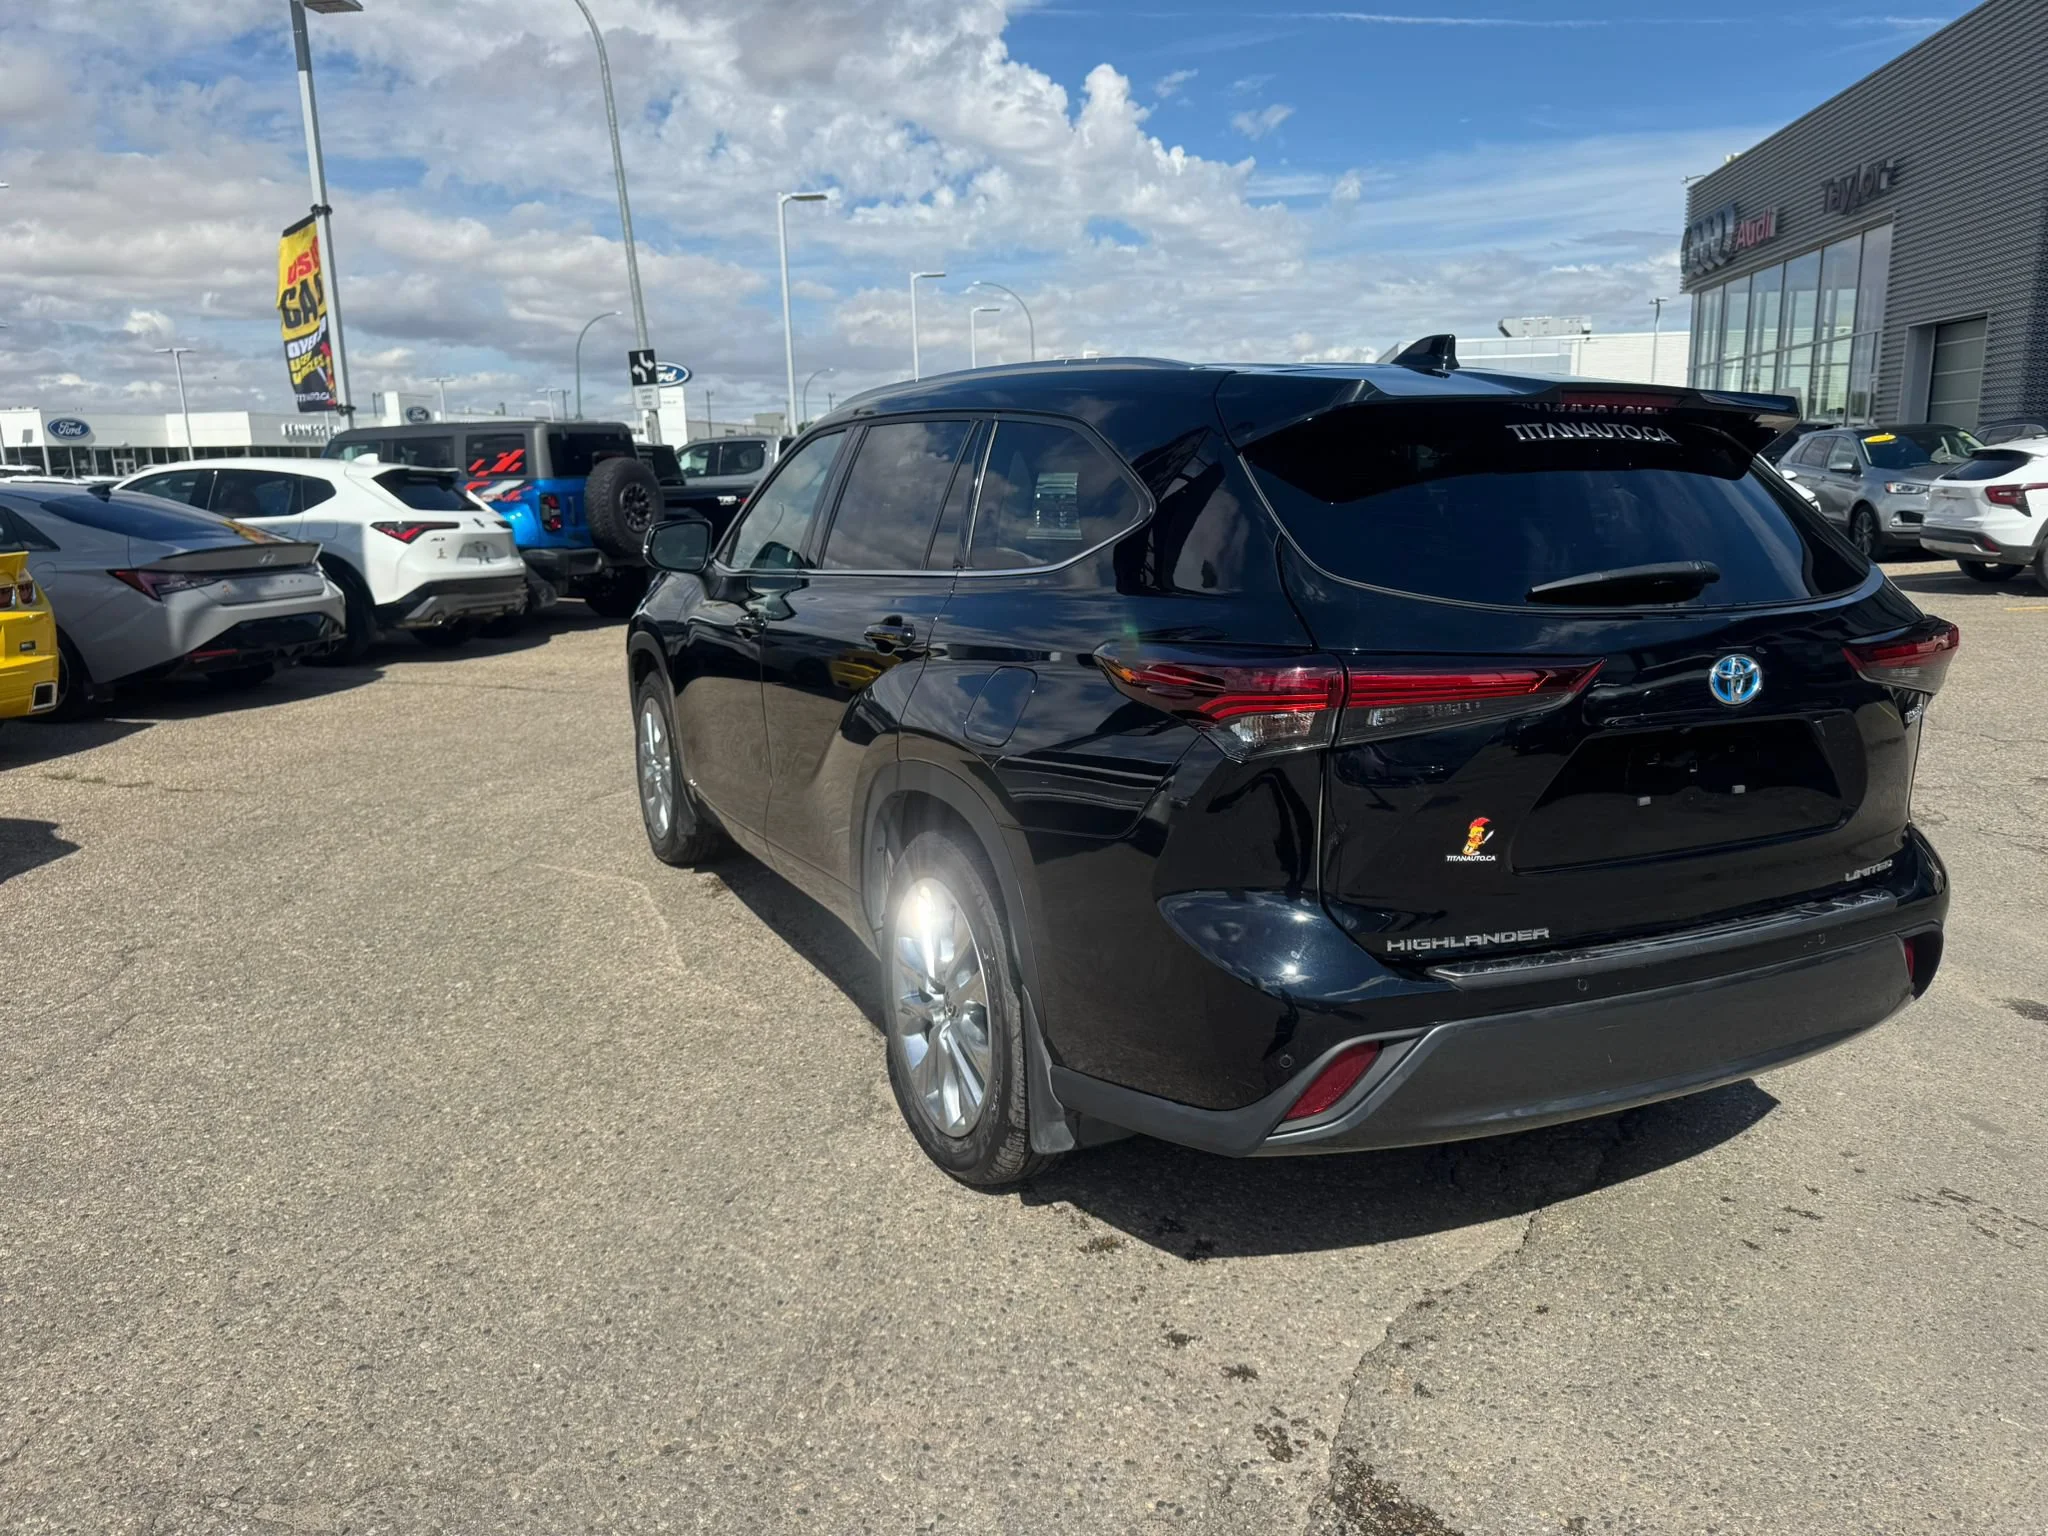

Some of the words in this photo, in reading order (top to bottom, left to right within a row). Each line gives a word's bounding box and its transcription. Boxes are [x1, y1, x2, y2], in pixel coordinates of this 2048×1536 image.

[1735, 207, 1779, 250] Audi
[1505, 422, 1678, 444] TITANAUTO.CA
[1387, 927, 1550, 952] HIGHLANDER
